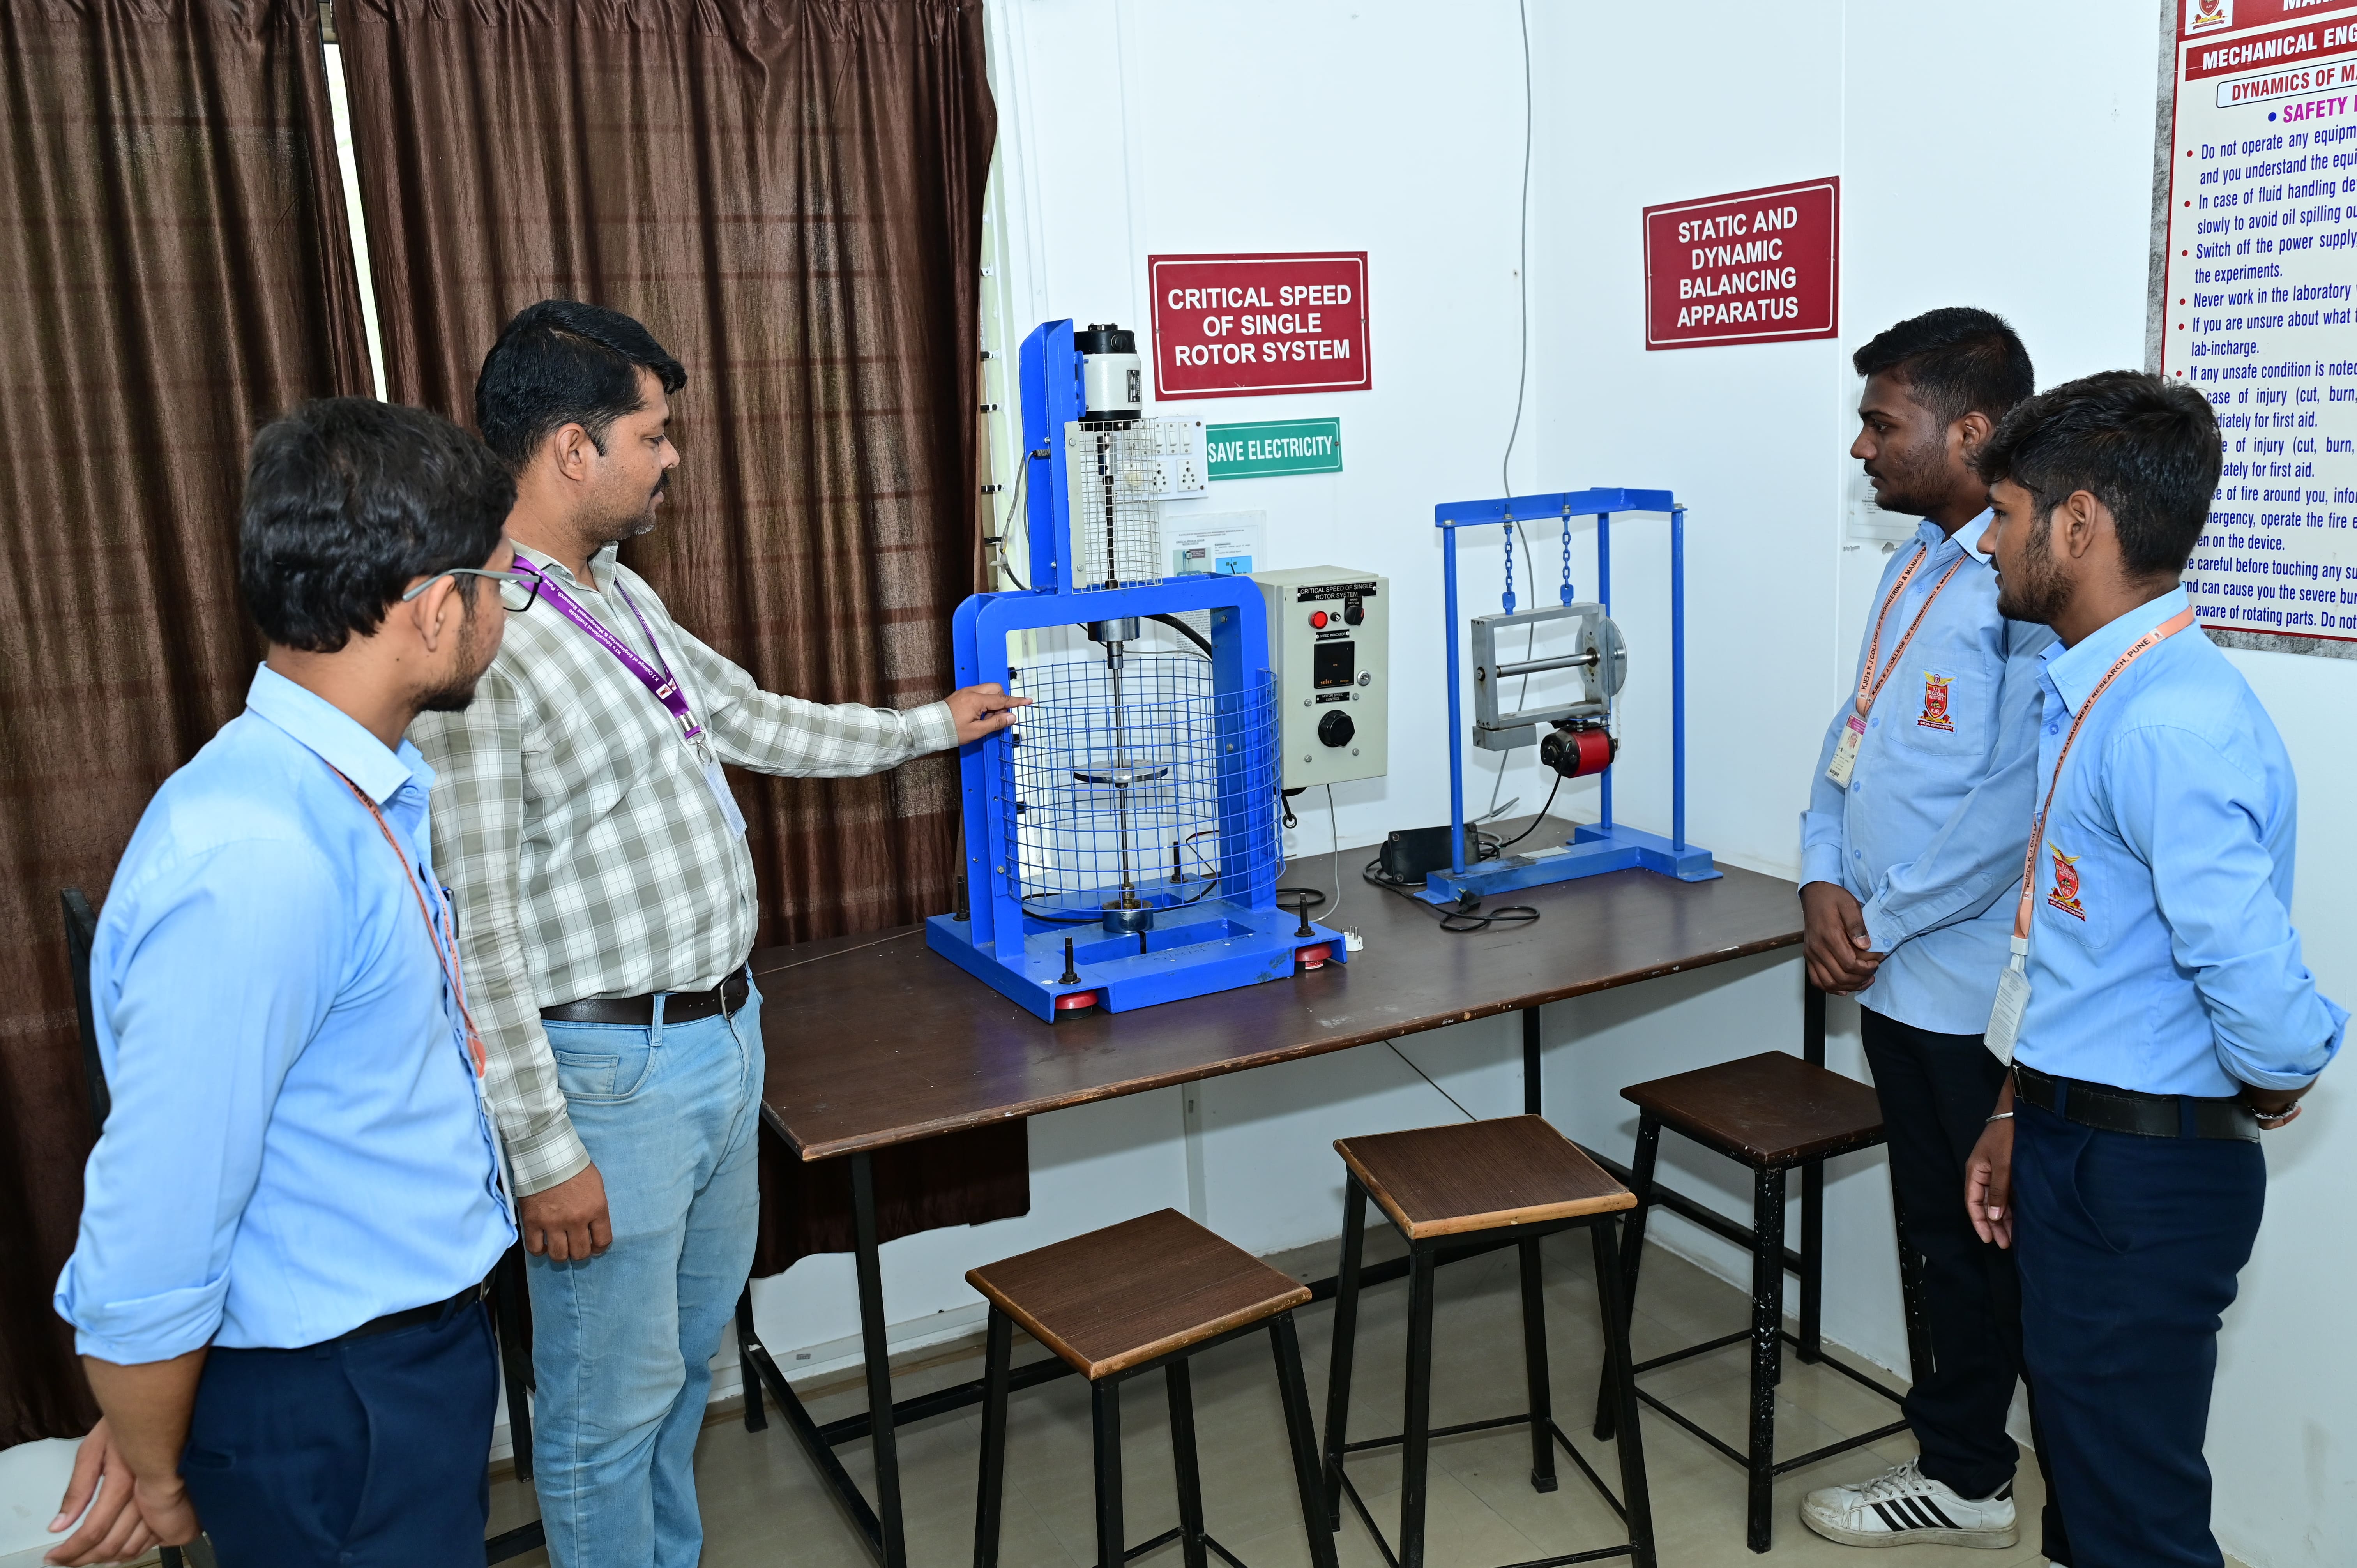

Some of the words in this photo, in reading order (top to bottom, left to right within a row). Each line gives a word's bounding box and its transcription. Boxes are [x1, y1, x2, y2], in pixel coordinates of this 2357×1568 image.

[2203, 32, 2317, 70] MECHANICAL
[2232, 72, 2309, 101] DYNAMICS
[2315, 67, 2335, 87] OF
[2283, 96, 2348, 123] SAFETY
[2202, 144, 2214, 160] Do
[2220, 140, 2237, 157] not
[2242, 134, 2283, 157] operate
[2289, 132, 2309, 149] any
[2200, 167, 2219, 185] and
[2223, 168, 2241, 185] you
[2246, 155, 2306, 179] understand
[2311, 154, 2328, 170] the
[2199, 194, 2208, 210] In
[2214, 193, 2237, 208] case
[2243, 188, 2253, 205] of
[2259, 184, 2282, 203] fluid
[2288, 179, 2336, 199] handling
[1678, 214, 1747, 243] STATIC
[1753, 206, 1797, 233] AND
[2198, 216, 2230, 235] slowly
[2234, 215, 2244, 230] to
[2249, 210, 2277, 229] avoid
[2282, 208, 2295, 226] oil
[2300, 205, 2341, 227] spilling
[1692, 238, 1783, 270] DYNAMIC
[2196, 241, 2230, 259] Switch
[2237, 238, 2251, 255] off
[2256, 237, 2273, 253] the
[2279, 236, 2313, 255] power
[1680, 267, 1796, 299] BALANCING
[2195, 268, 2210, 284] the
[2215, 262, 2282, 284] experiments.
[1168, 287, 1273, 310] CRITICAL
[1279, 284, 1352, 306] SPEED
[2194, 293, 2224, 308] Never
[2228, 289, 2254, 305] work
[2258, 288, 2267, 304] in
[2272, 286, 2288, 302] the
[2293, 283, 2351, 301] laboratory
[1677, 297, 1798, 327] APPARATUS
[2193, 317, 2200, 332] If
[2203, 319, 2221, 335] you
[2226, 318, 2242, 330] are
[2247, 315, 2283, 329] unsure
[2288, 310, 2319, 327] about
[2323, 308, 2350, 325] what
[1203, 316, 1234, 337] OF
[1241, 313, 1322, 335] SINGLE
[1175, 343, 1257, 366] ROTOR
[1262, 339, 1350, 362] SYSTEM
[2191, 339, 2259, 358] lab-incharge.
[2190, 366, 2197, 380] If
[2201, 368, 2219, 383] any
[2223, 363, 2257, 380] unsafe
[2262, 361, 2311, 378] condition
[2315, 360, 2324, 376] is
[2207, 392, 2230, 404] case
[2239, 388, 2249, 404] of
[2256, 387, 2287, 406] injury
[2296, 386, 2320, 406] (cut,
[2255, 412, 2269, 428] for
[2273, 412, 2294, 427] first
[2298, 411, 2317, 427] aid.
[1208, 441, 1244, 463] SAVE
[1248, 436, 1333, 460] ELECTRICITY
[2236, 437, 2246, 452] of
[2254, 437, 2284, 456] injury
[2293, 436, 2316, 456] (cut,
[2326, 436, 2354, 454] burn,
[2252, 461, 2267, 477] for
[2270, 461, 2291, 477] first
[2295, 462, 2314, 477] aid.
[2227, 485, 2237, 500] of
[2241, 486, 2258, 501] fire
[2263, 487, 2300, 502] around
[2306, 490, 2328, 506] you,
[2261, 512, 2301, 529] operate
[2306, 512, 2323, 528] the
[2329, 512, 2347, 528] fire
[2213, 536, 2224, 547] on
[2228, 533, 2244, 549] the
[2248, 534, 2285, 551] device.
[2197, 556, 2232, 572] careful
[2236, 557, 2269, 574] before
[2272, 560, 2318, 580] touching
[2322, 565, 2342, 582] any
[544, 578, 555, 592] Pune
[2202, 582, 2220, 594] can
[2223, 584, 2253, 597] cause
[2257, 586, 2275, 601] you
[2279, 584, 2295, 600] the
[2299, 589, 2336, 603] severe
[569, 609, 588, 627] Institute
[577, 609, 604, 634] Management
[1888, 640, 1906, 668] COLLEGE
[1905, 631, 1911, 640] OF
[1910, 591, 1936, 631] ENGINEERING
[2196, 605, 2226, 618] aware
[2230, 605, 2239, 619] of
[2242, 607, 2282, 627] rotating
[2286, 611, 2316, 627] parts.
[2321, 611, 2335, 628] Do
[2339, 614, 2357, 629] not
[587, 625, 612, 648] Educational
[609, 634, 633, 659] Engineering
[1861, 671, 1871, 690] KJEI's
[1870, 630, 1879, 660] COLLEGE
[1877, 621, 1882, 630] OF
[1880, 581, 1904, 620] ENGINEERING
[638, 660, 654, 676] College
[2063, 698, 2092, 754] MANAGEMENT
[2091, 658, 2129, 698] RESEARCH,
[2127, 638, 2151, 657] PUNE
